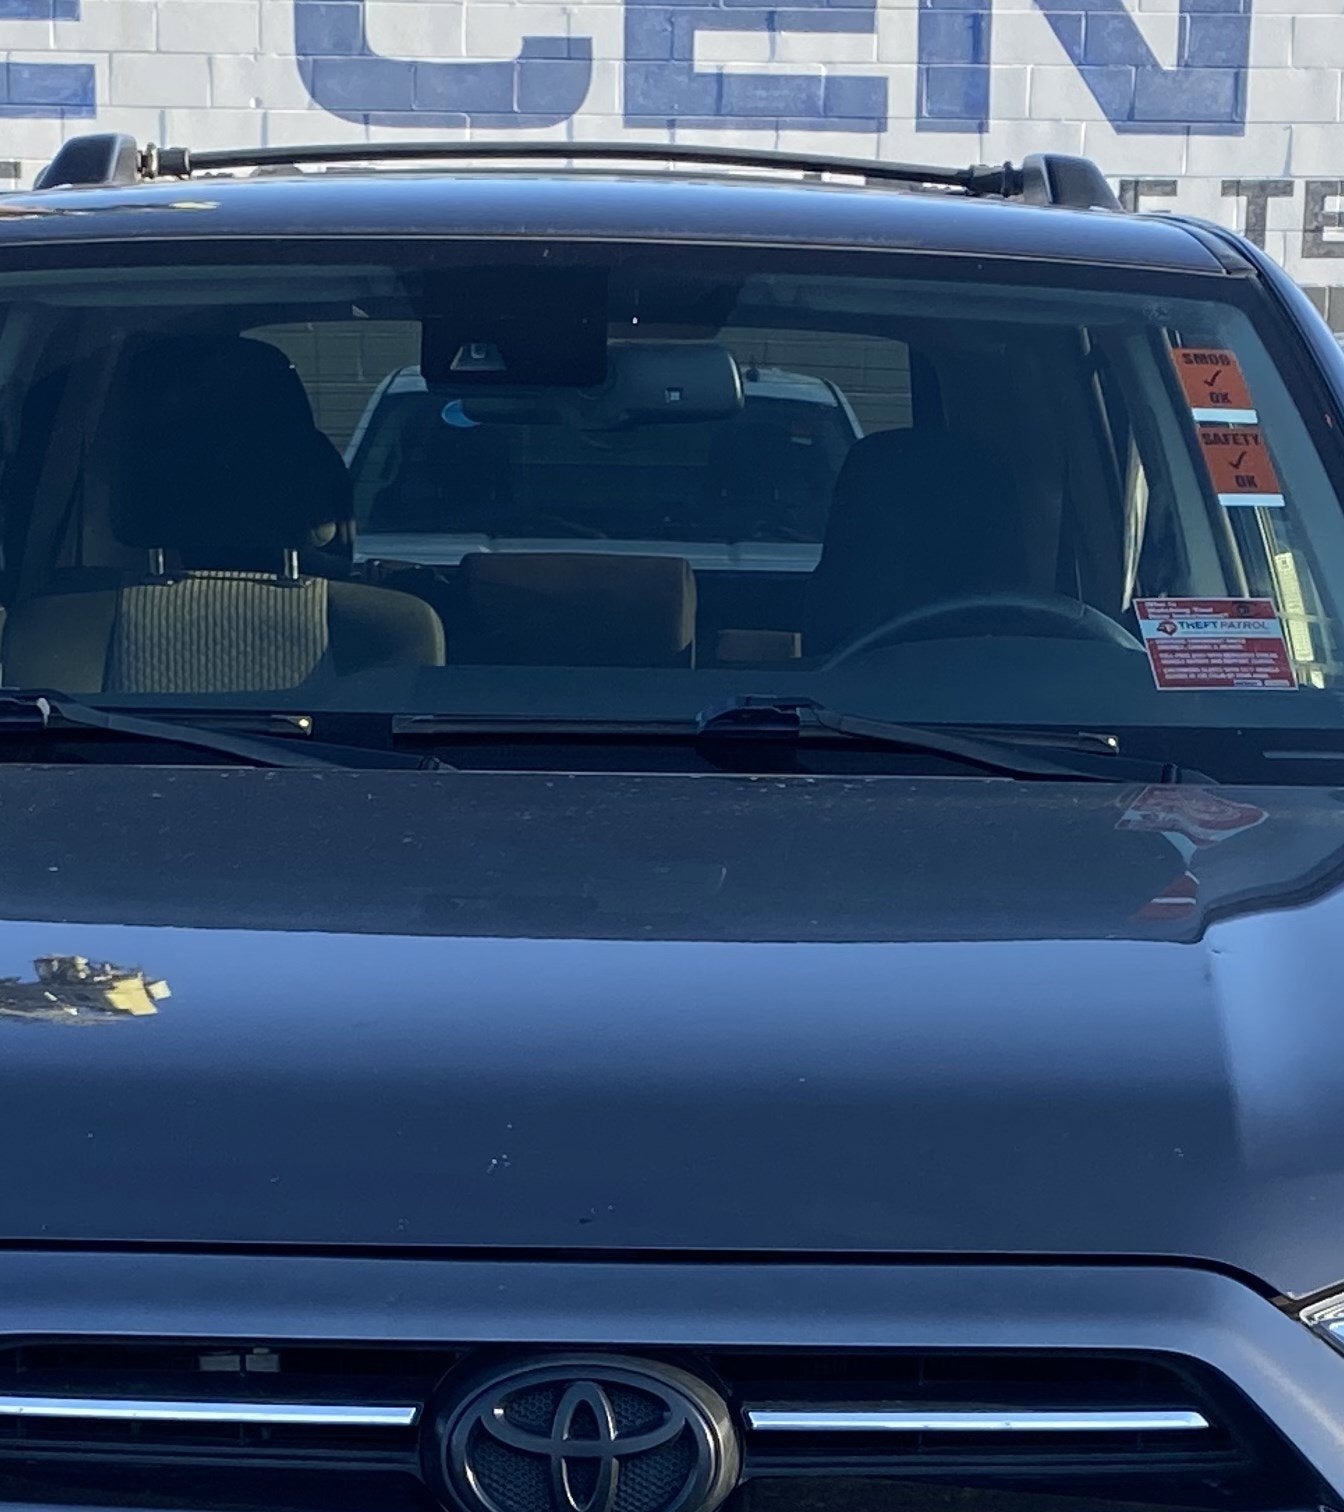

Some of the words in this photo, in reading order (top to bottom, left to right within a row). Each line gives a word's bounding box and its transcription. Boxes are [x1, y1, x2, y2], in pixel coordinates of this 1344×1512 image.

[1209, 391, 1232, 404] OK
[1201, 432, 1260, 446] SAFETY
[1234, 474, 1258, 488] OK
[1178, 620, 1219, 630] THEFT
[1220, 620, 1268, 630] PATROL
